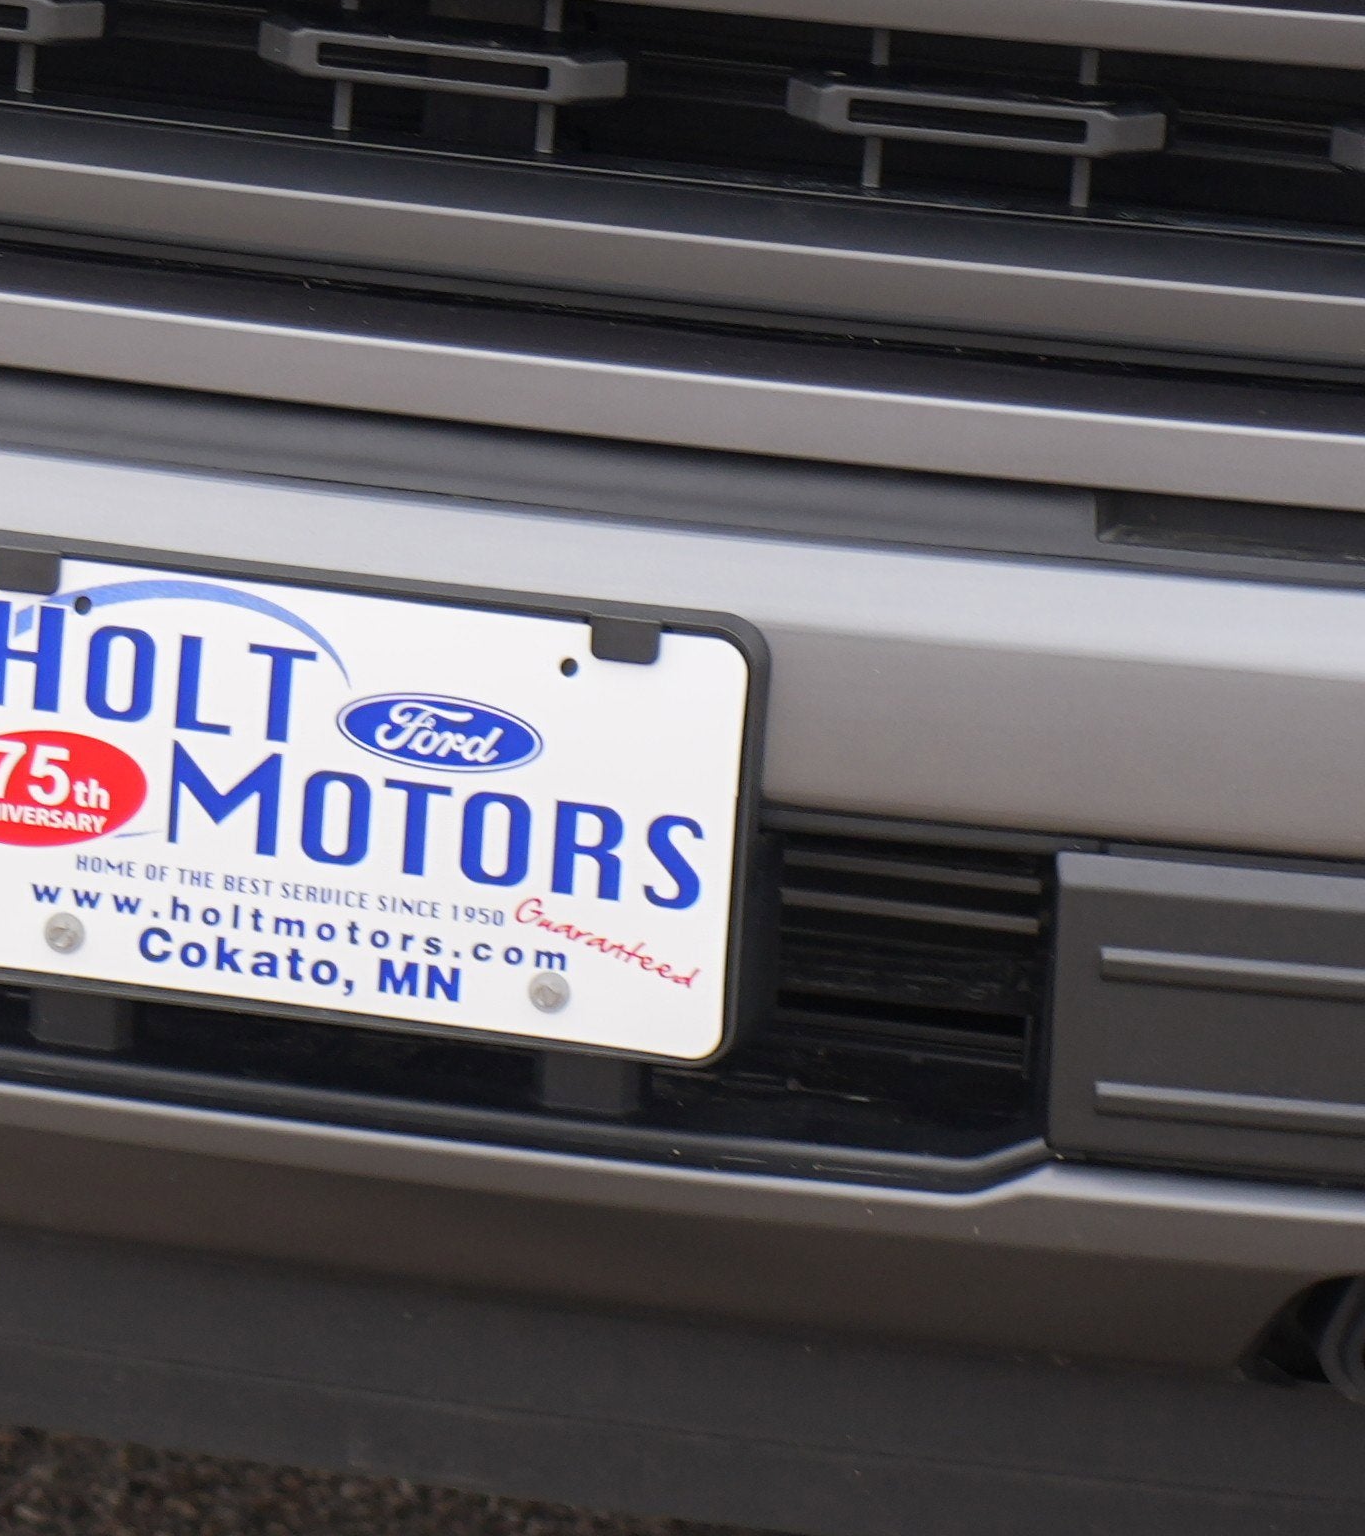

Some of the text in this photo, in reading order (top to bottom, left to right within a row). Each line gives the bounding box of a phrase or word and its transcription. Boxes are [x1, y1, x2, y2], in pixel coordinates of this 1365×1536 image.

[375, 700, 505, 765] Ford
[165, 739, 705, 911] MOTORS
[31, 882, 568, 972] www.holtmotors.com
[76, 854, 506, 927] HOME OF THE BEST SERVICE SINCE 1950
[138, 926, 463, 1003] Cokato, MN
[515, 897, 700, 989] Guaranteed
